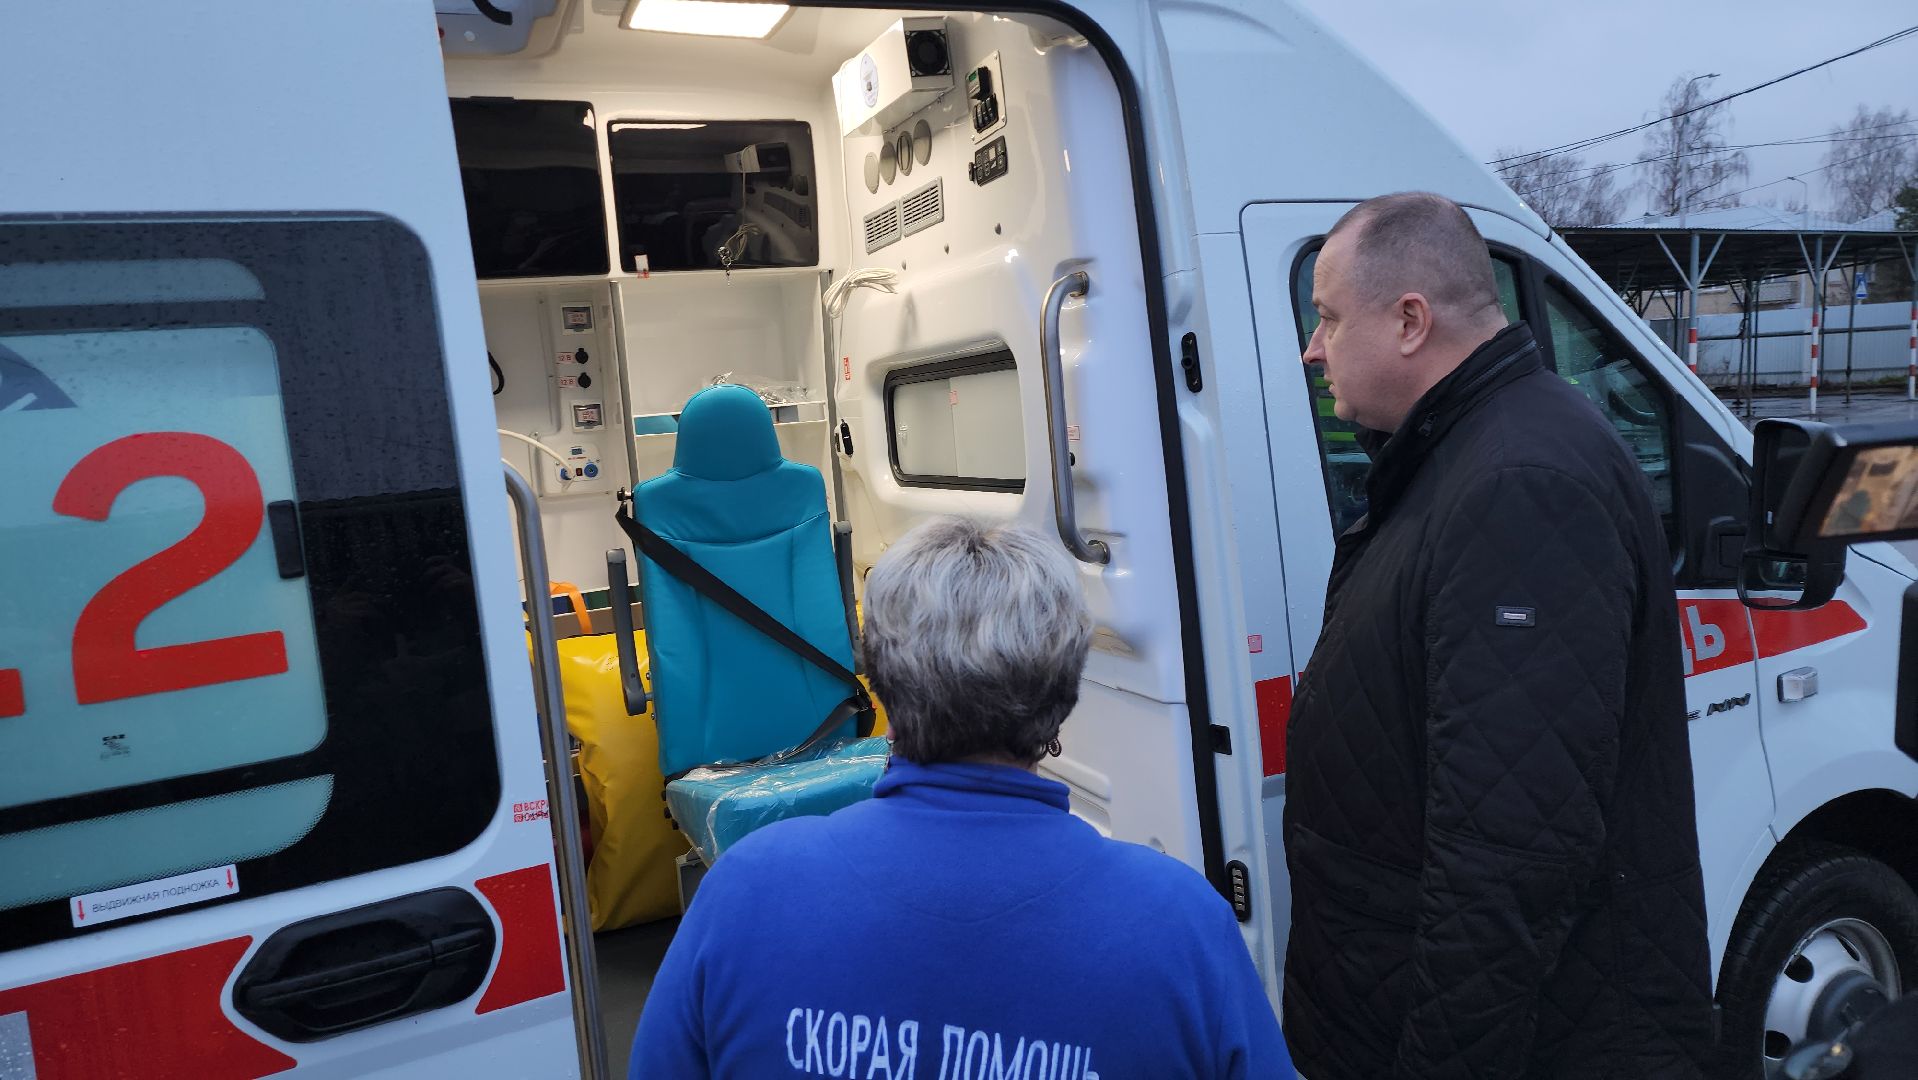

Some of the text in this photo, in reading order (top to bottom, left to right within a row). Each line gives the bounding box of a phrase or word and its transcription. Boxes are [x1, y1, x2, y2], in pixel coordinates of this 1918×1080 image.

[0, 431, 289, 718] 2
[92, 879, 221, 914] ВЫДВИЖНАЯ ПОДНОЖКА
[786, 1007, 919, 1080] СКОРАЯ
